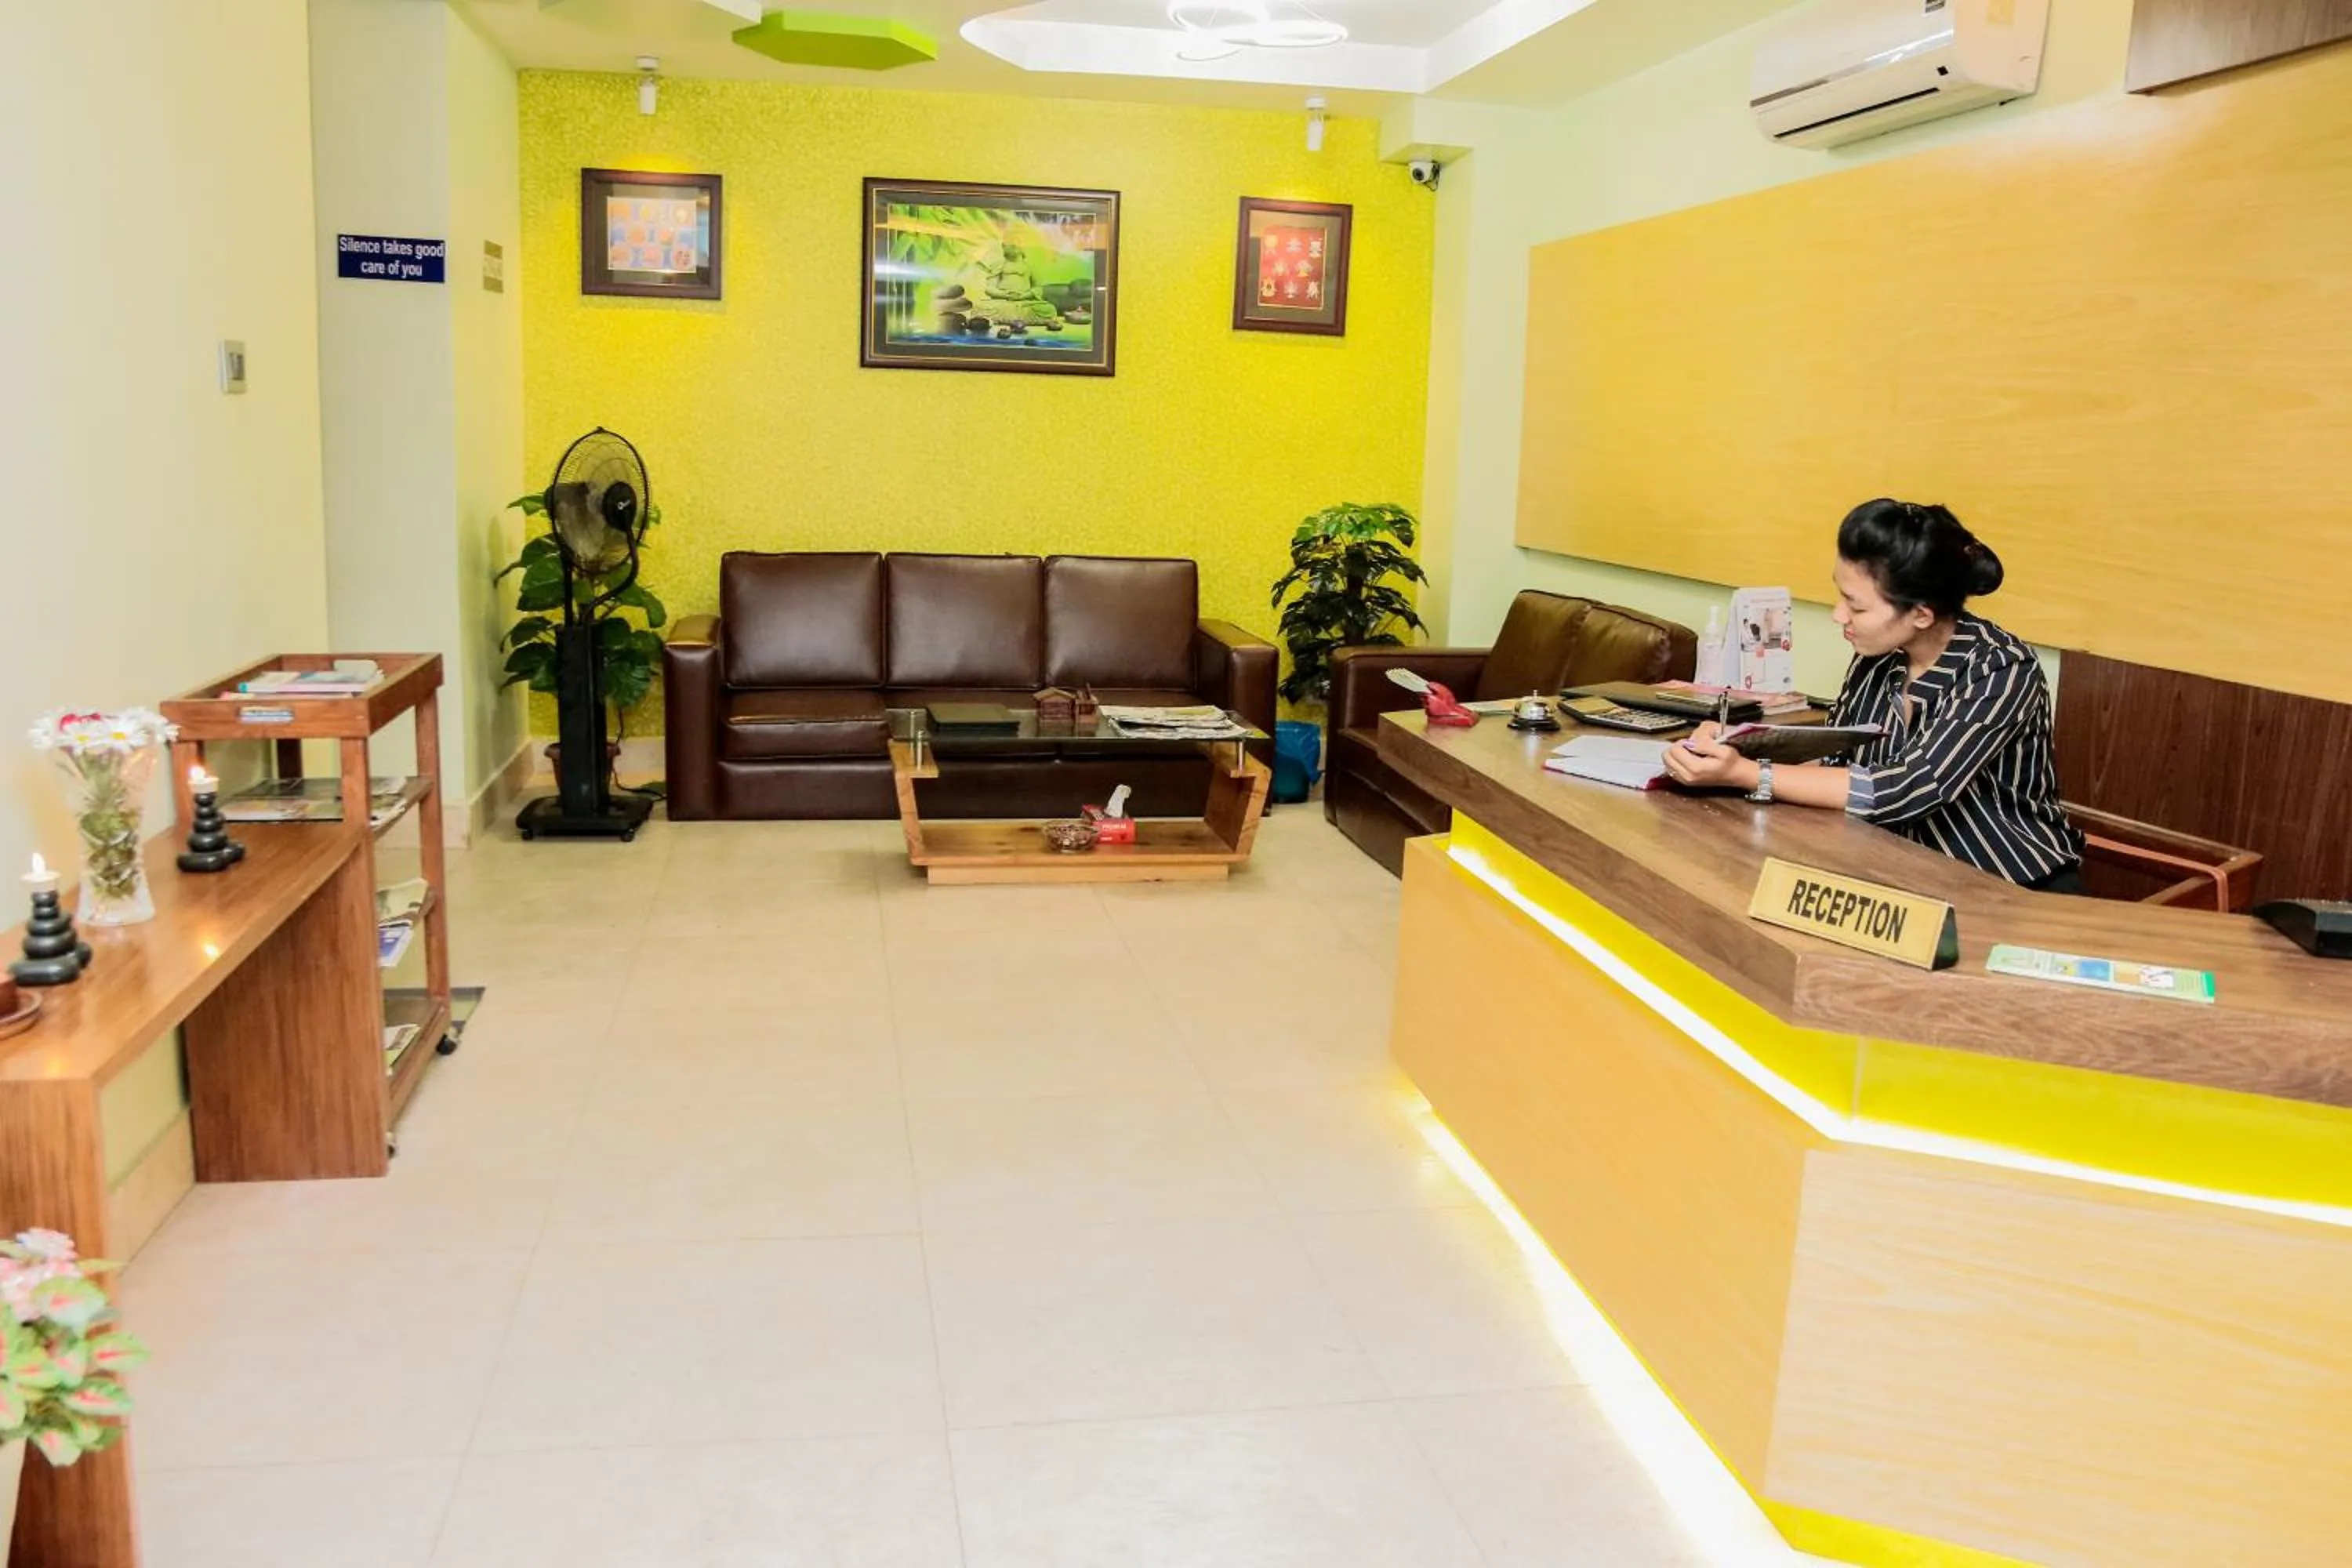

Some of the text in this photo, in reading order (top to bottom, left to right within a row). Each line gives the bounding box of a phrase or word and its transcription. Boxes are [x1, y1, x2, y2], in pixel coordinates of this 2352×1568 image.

[339, 237, 445, 260] Silence takes good
[361, 260, 423, 278] care of you
[1788, 879, 1907, 942] RECEPTION
